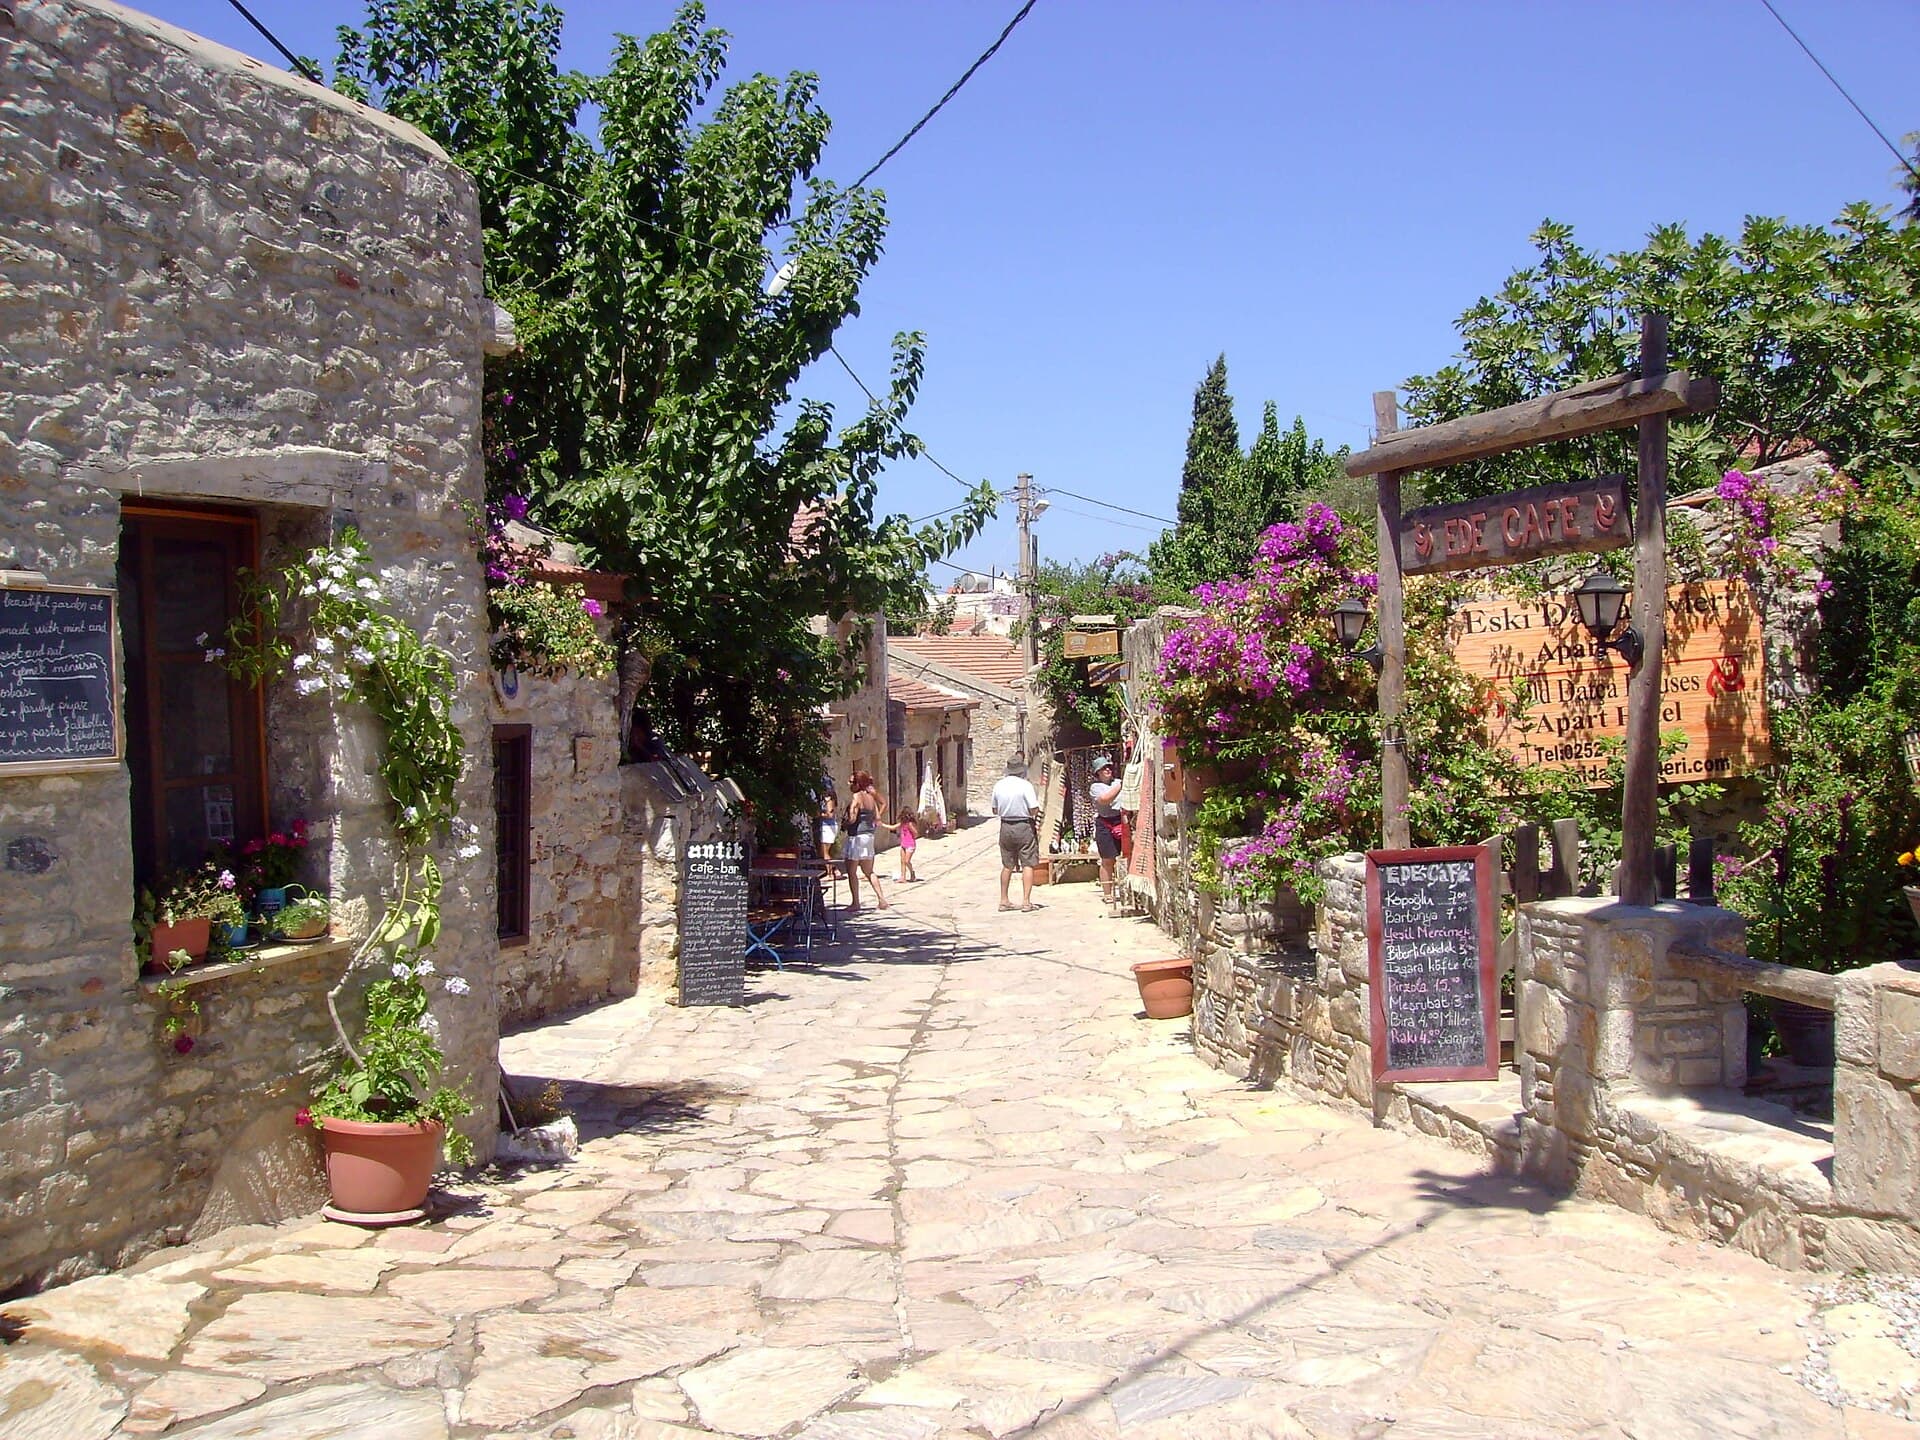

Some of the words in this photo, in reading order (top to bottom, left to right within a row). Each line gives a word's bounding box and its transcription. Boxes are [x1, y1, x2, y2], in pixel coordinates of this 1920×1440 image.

[1444, 513, 1489, 556] EDE
[1502, 496, 1581, 548] CAFE
[51, 597, 87, 615] garden
[89, 599, 104, 611] at
[1540, 602, 1632, 627] Daa
[34, 620, 62, 635] with
[63, 620, 85, 633] mint
[88, 621, 107, 634] and
[25, 644, 45, 657] and
[1537, 707, 1609, 737] Apart
[1617, 701, 1682, 727] Hel
[688, 841, 745, 860] antik
[690, 860, 740, 875] cafe-bar
[1384, 909, 1438, 927] Barbunya
[1388, 976, 1428, 993] Pirzola
[1390, 1011, 1415, 1027] Bira
